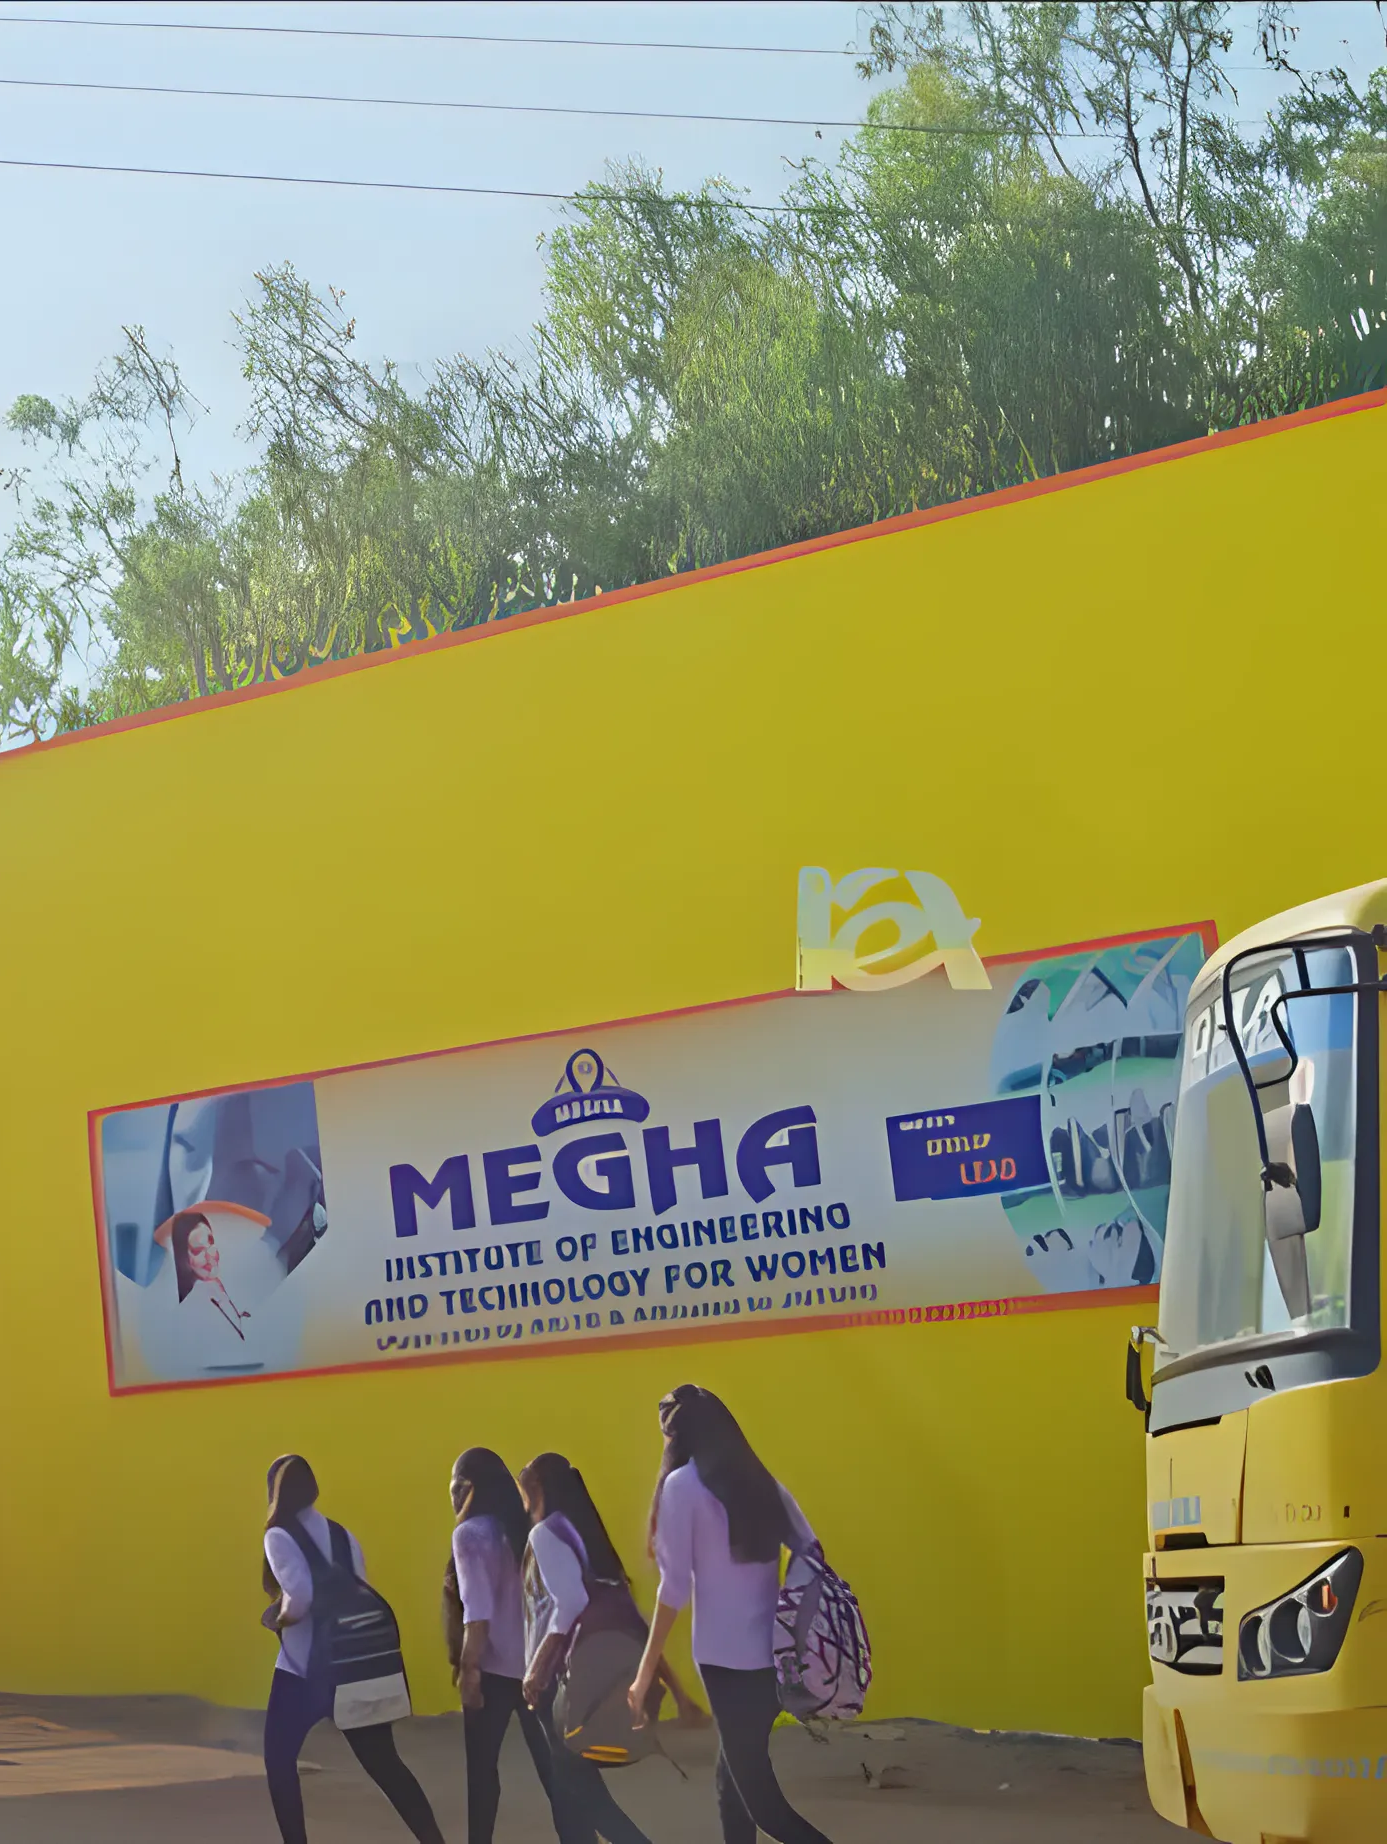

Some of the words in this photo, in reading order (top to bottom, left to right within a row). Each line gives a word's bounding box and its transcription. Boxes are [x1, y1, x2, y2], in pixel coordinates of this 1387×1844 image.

[388, 1105, 822, 1239] MEGHA
[555, 1232, 597, 1262] OF
[664, 1258, 735, 1294] FOR
[745, 1241, 887, 1284] WOMEN
